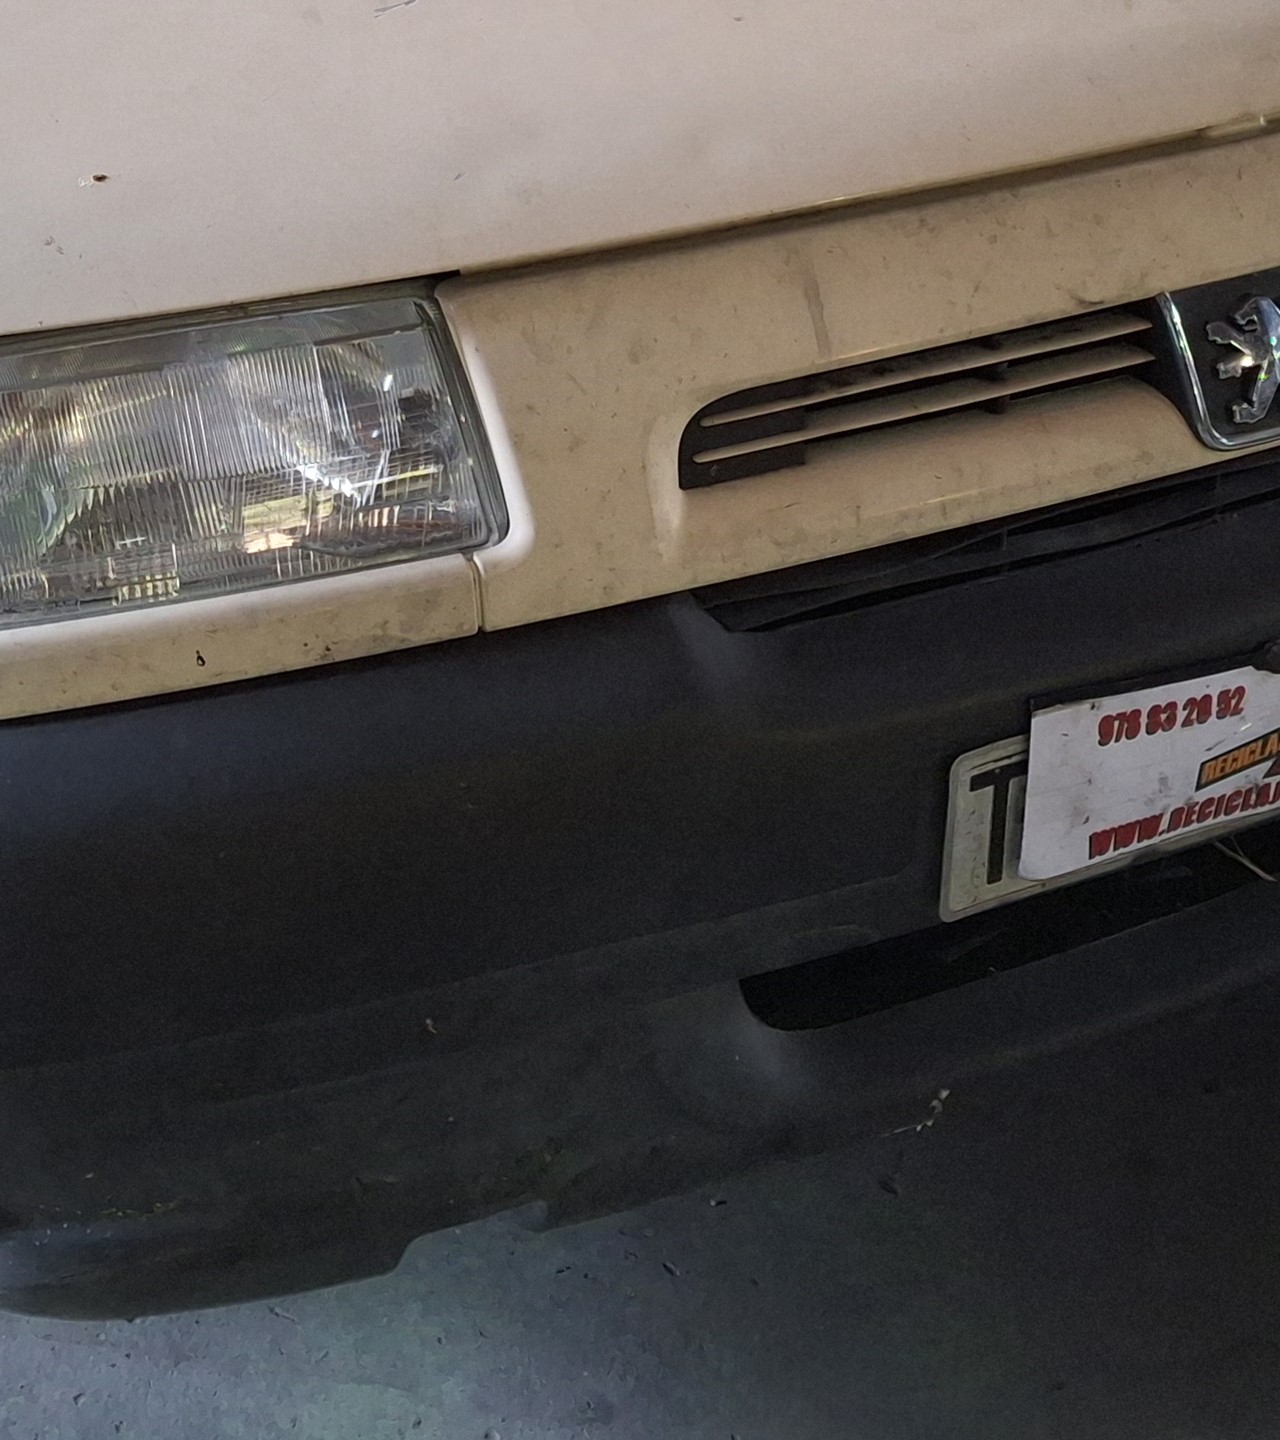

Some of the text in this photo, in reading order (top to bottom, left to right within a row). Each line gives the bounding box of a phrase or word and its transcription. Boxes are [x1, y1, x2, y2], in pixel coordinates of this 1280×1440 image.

[1098, 709, 1142, 747] 978
[1216, 686, 1247, 720] 52
[969, 758, 1030, 886] T
